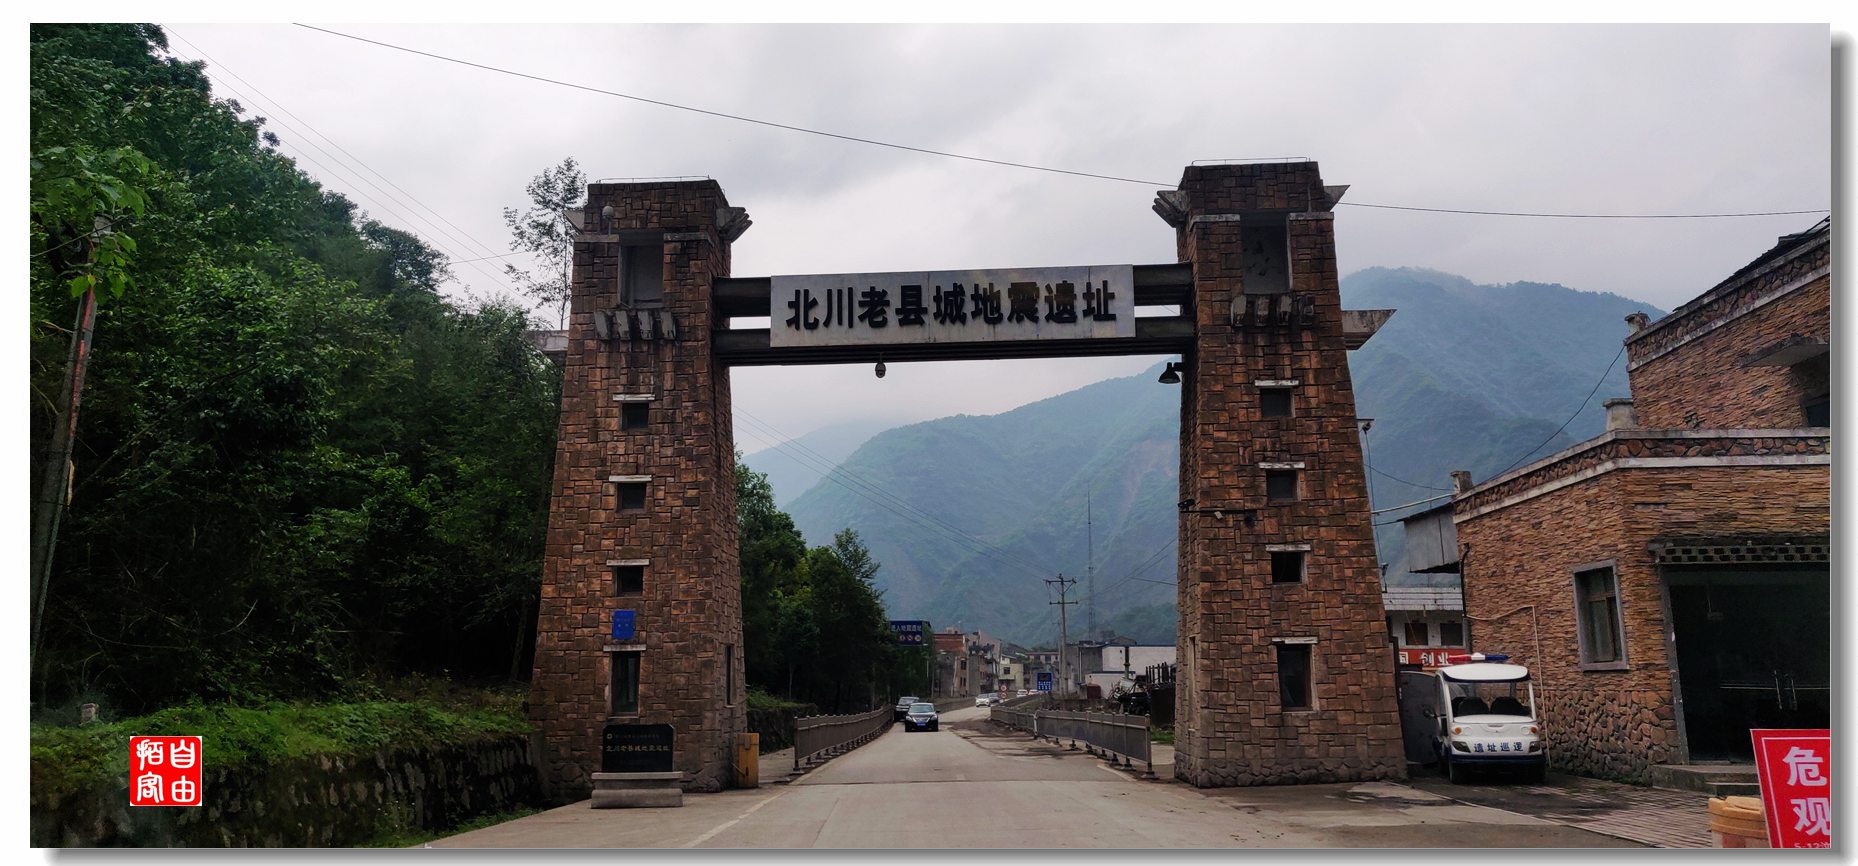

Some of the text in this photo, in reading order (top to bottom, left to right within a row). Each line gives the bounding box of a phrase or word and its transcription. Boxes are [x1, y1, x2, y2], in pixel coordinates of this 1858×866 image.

[786, 279, 1117, 331] 北川老县城地震遗址
[1474, 741, 1524, 753] 遗址巡逻
[1782, 746, 1828, 786] 危
[1790, 797, 1830, 836] 观
